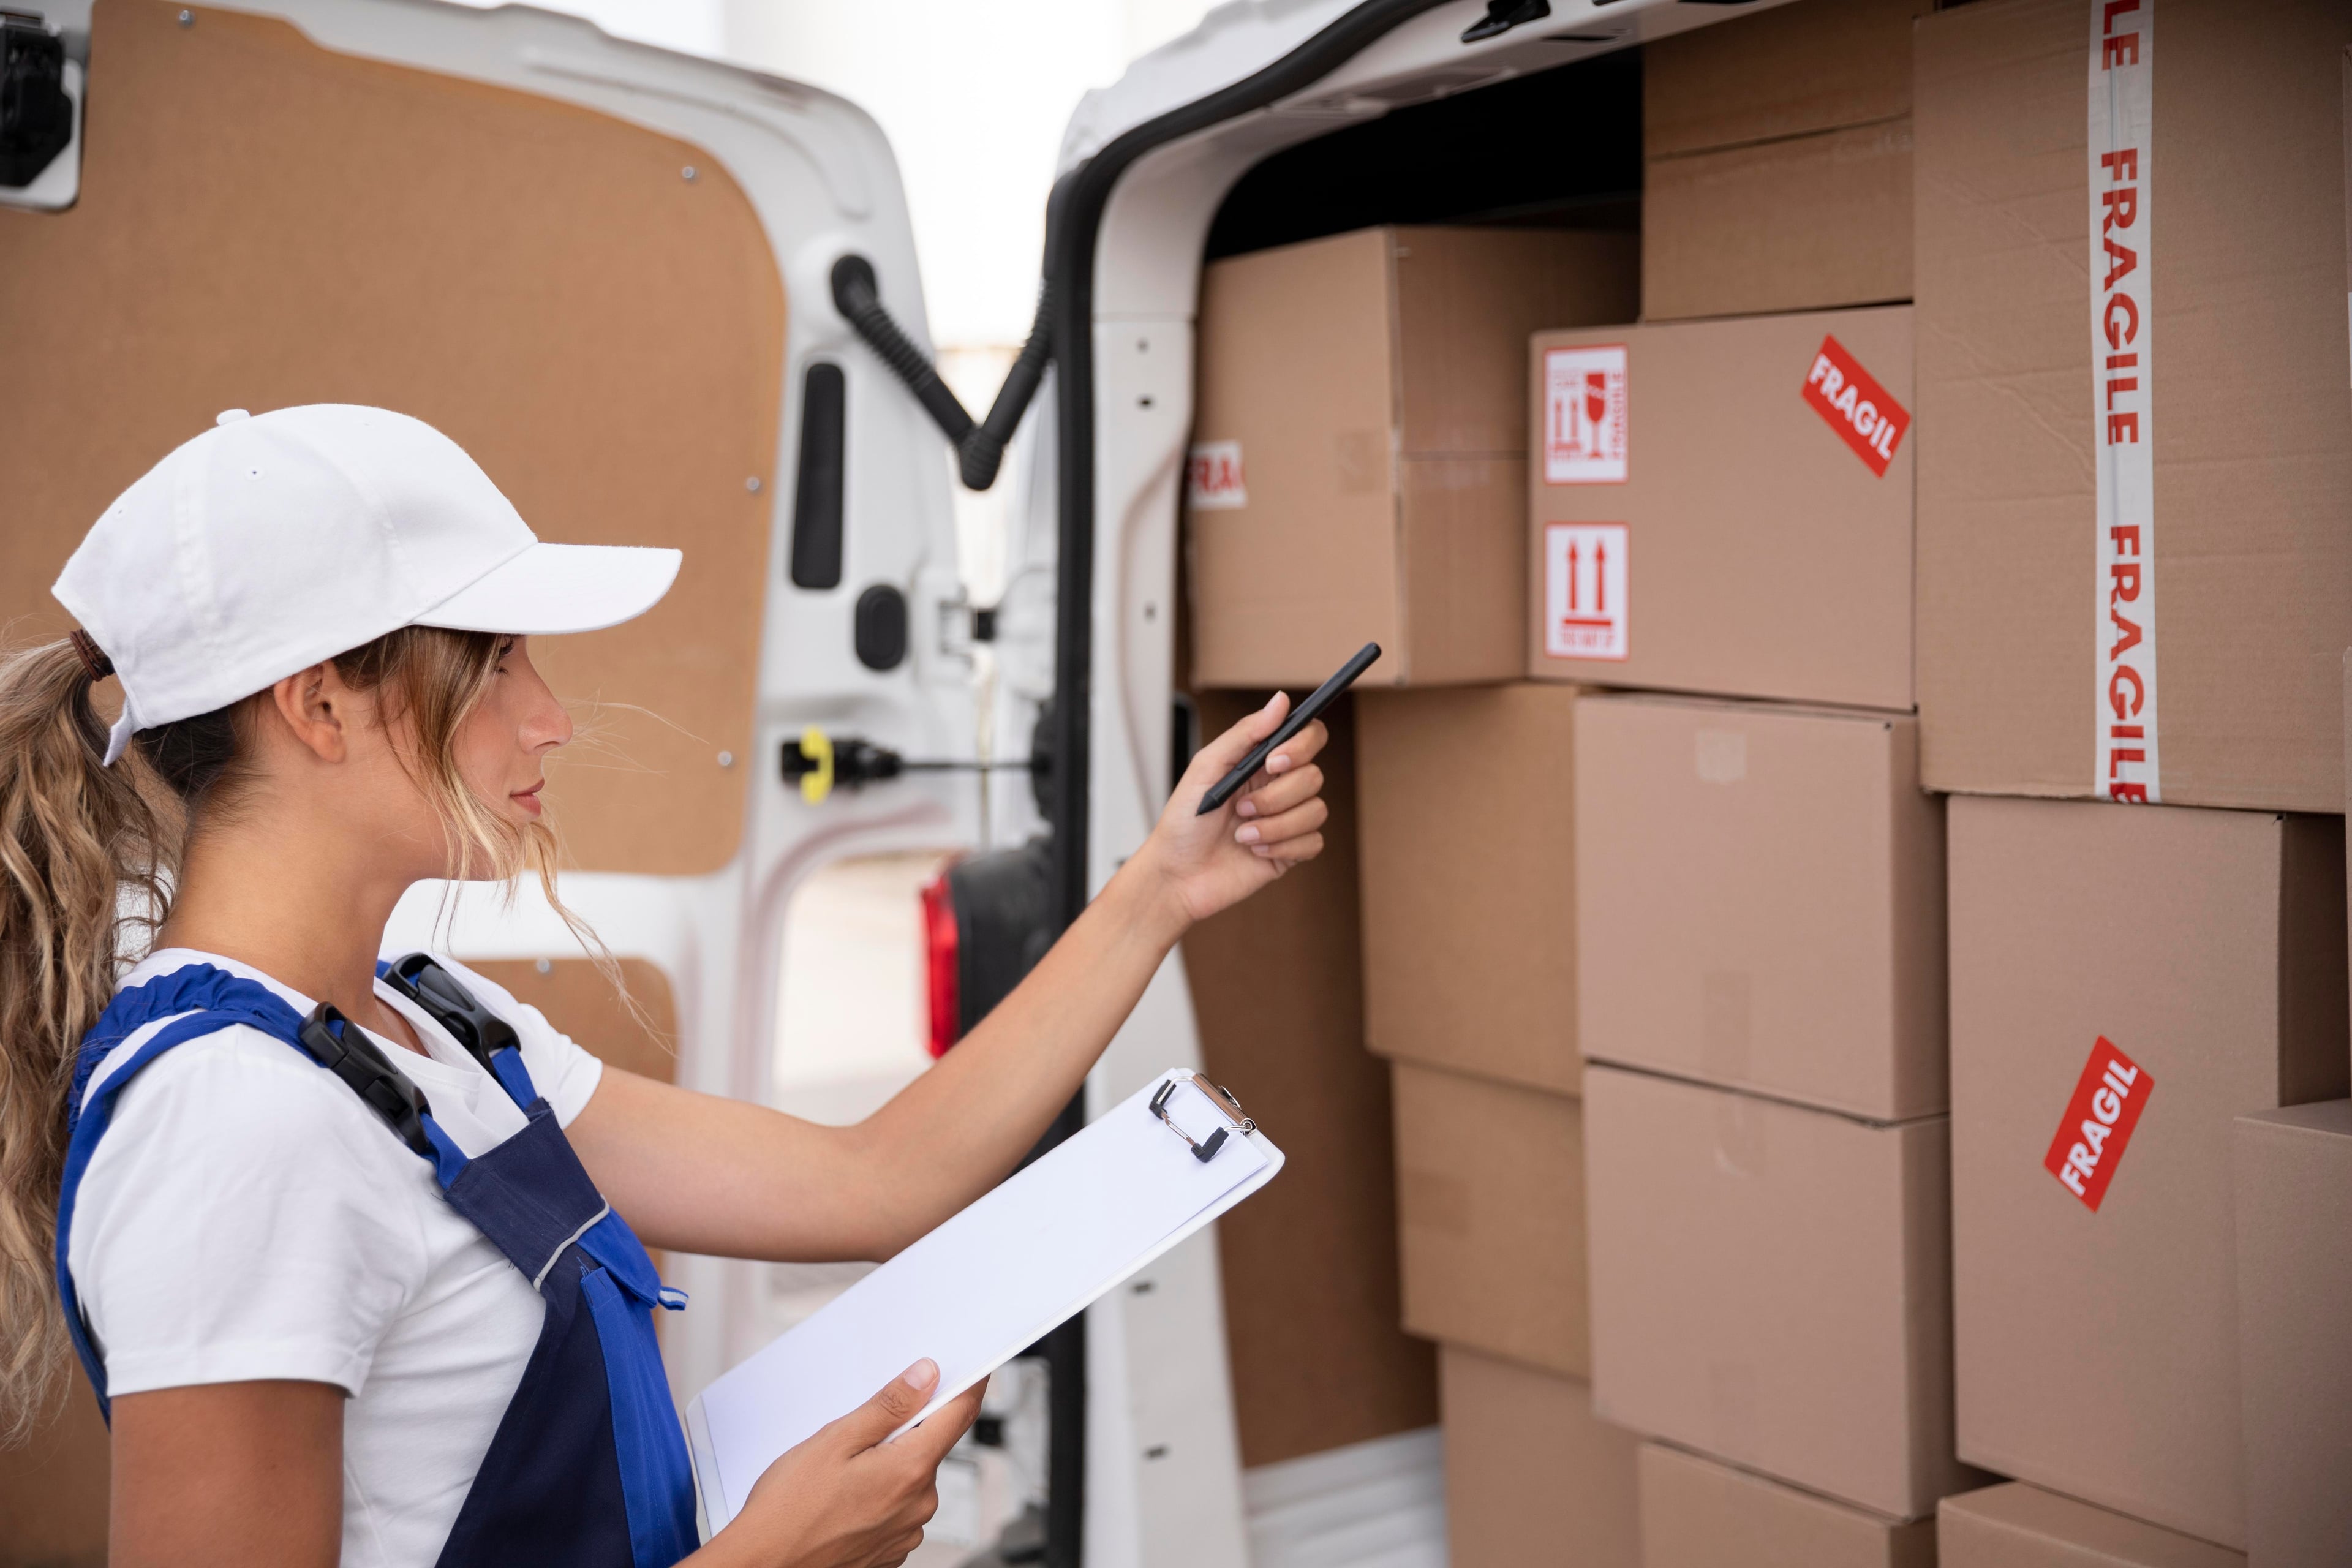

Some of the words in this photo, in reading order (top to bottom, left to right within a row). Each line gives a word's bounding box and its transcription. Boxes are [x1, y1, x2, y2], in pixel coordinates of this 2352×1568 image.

[2101, 147, 2139, 445] FRAGILE
[1809, 353, 1896, 460] FRAGIL
[2109, 524, 2148, 803] FRAGILE
[2059, 1059, 2138, 1196] FRAGIL
